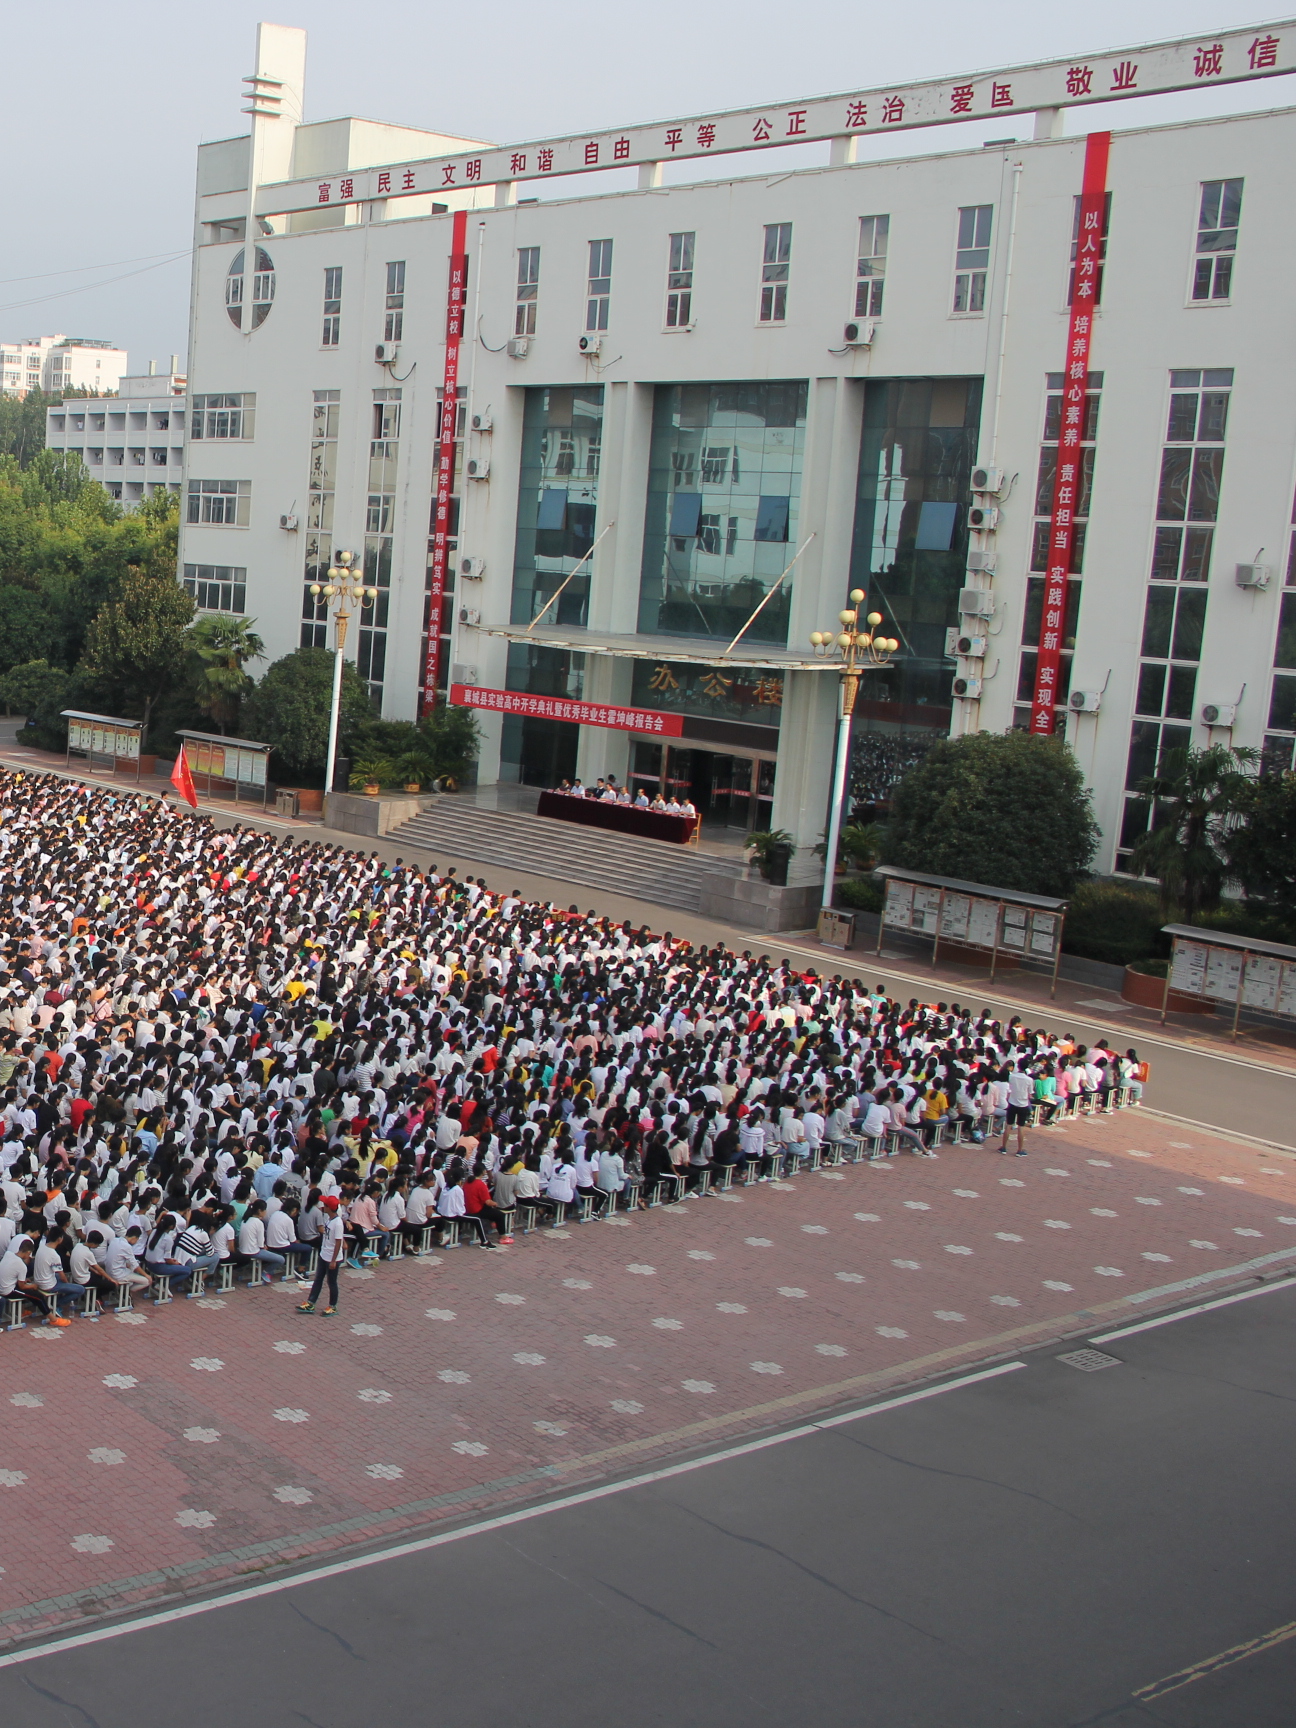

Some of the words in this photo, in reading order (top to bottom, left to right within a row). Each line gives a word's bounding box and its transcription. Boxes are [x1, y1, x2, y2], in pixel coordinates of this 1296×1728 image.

[317, 179, 354, 203] 富强
[377, 168, 416, 194] 民主
[441, 158, 482, 185] 文明
[510, 148, 554, 175] 和谐
[584, 136, 630, 165] 自由
[664, 123, 716, 152] 平等
[752, 110, 807, 141] 公正
[846, 95, 905, 128] 法治
[949, 81, 1014, 115] 爱国
[1066, 61, 1138, 98] 敬业
[1193, 35, 1280, 79] 诚信
[1077, 211, 1098, 299] 以人为本
[450, 270, 461, 334] 以德立校
[442, 347, 456, 444] 树立核心价值
[1063, 315, 1089, 447] 培养核心素养
[438, 456, 450, 520] 勤学修德
[1054, 463, 1075, 549] 责任担当
[432, 532, 445, 595] 明辨笃实
[1043, 565, 1065, 651] 实践创新
[425, 607, 440, 703] 成就国之栋梁
[648, 664, 784, 707] 办公楼
[1035, 666, 1054, 736] 实现全
